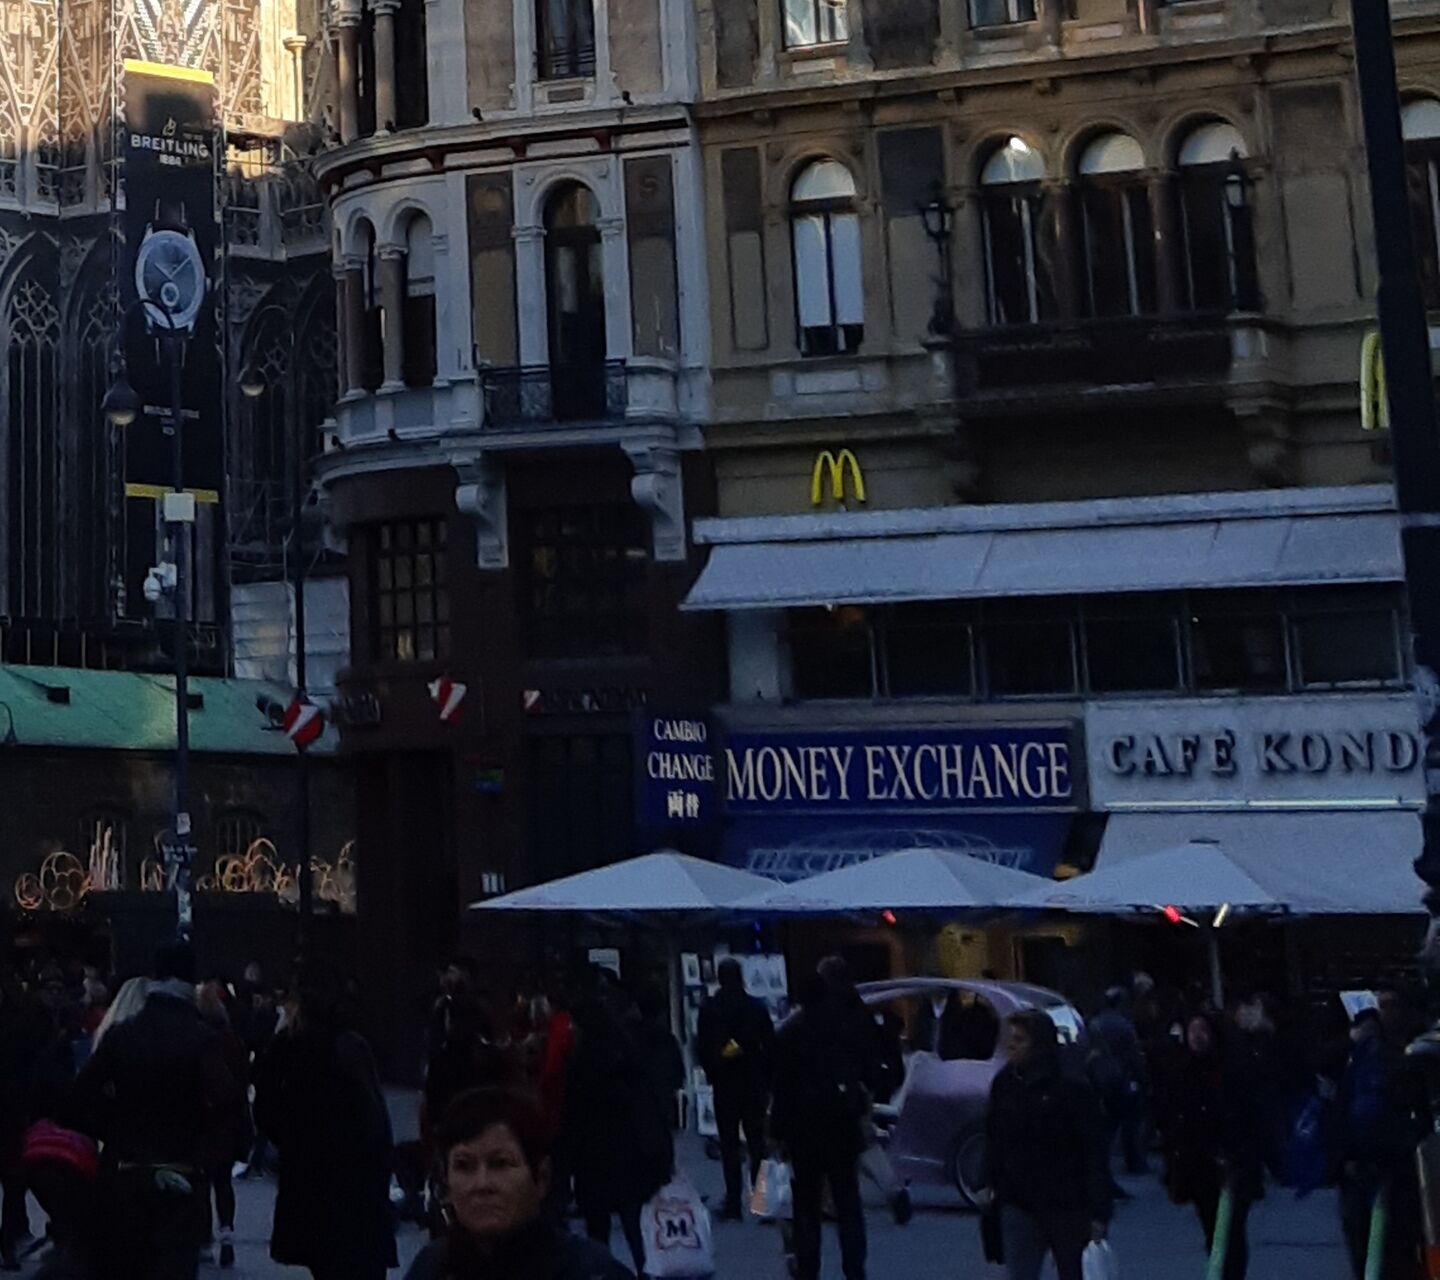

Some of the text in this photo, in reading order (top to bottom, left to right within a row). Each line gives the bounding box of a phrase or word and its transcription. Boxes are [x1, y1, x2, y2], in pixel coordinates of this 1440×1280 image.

[130, 134, 209, 158] BREITLING
[653, 718, 707, 743] CAMBIO
[647, 751, 715, 782] CHANGE
[725, 741, 1072, 801] MONEY EXCHANGE
